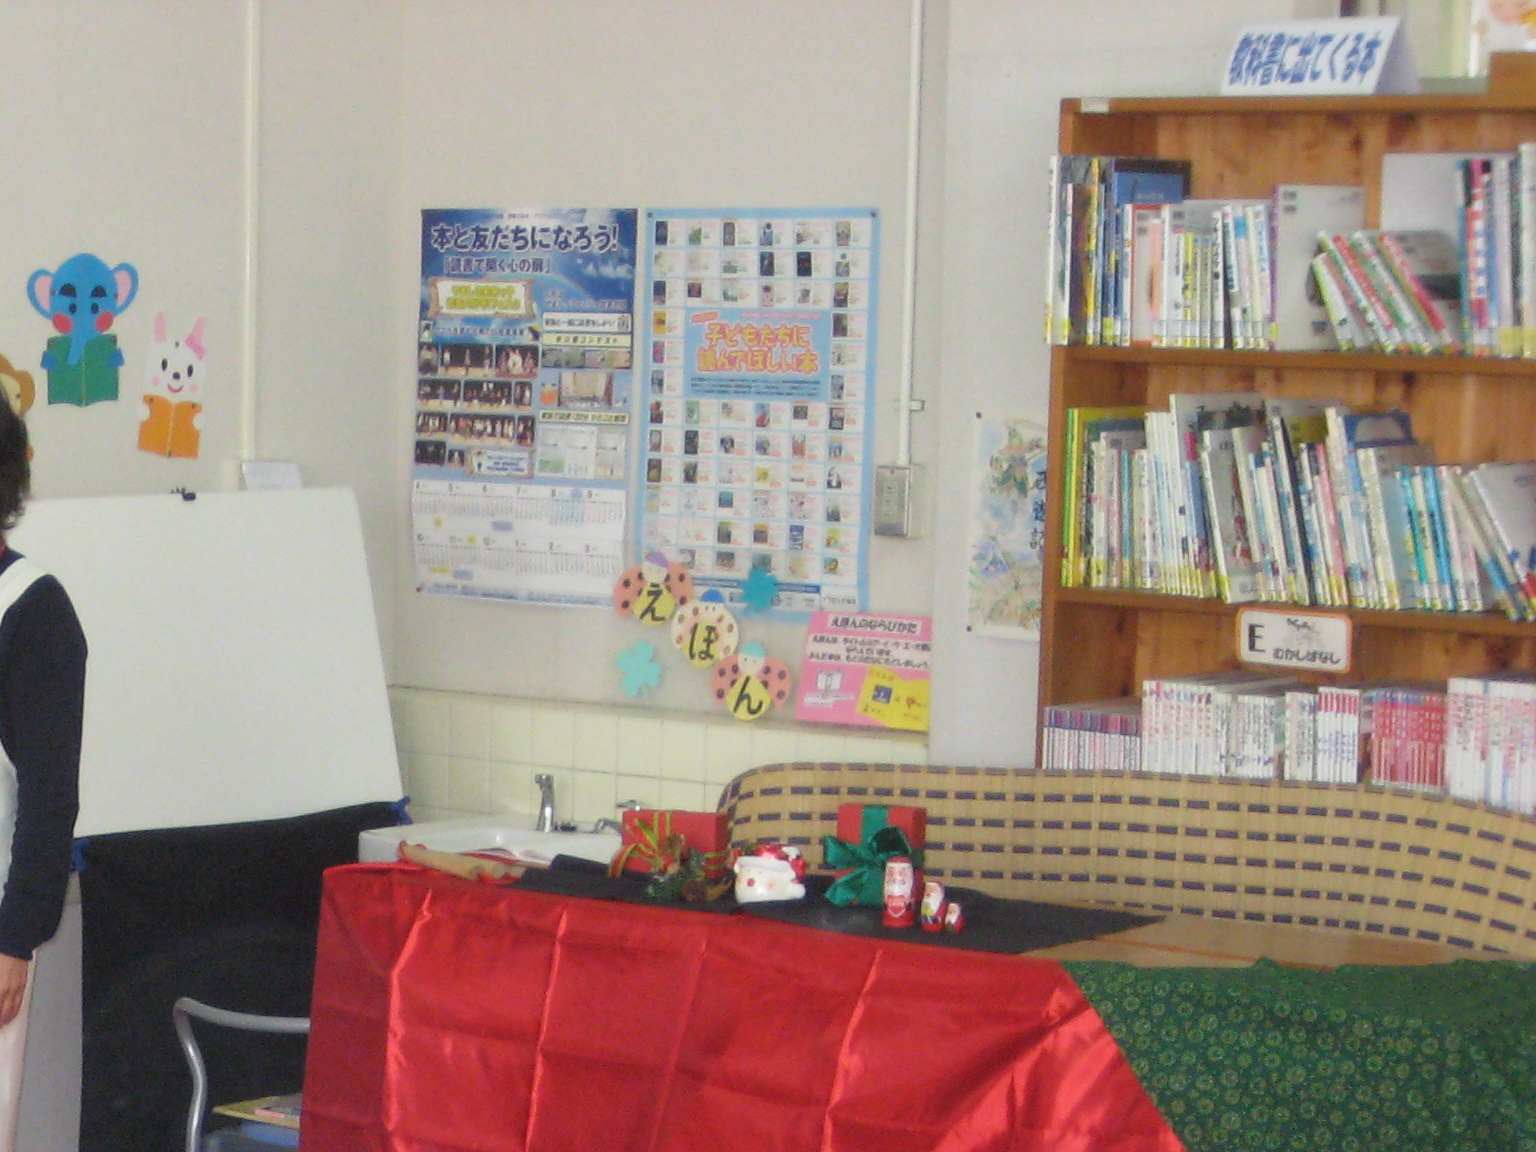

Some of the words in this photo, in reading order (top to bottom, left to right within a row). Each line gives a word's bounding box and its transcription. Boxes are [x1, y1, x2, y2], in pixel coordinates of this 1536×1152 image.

[706, 321, 812, 348] 子どもたちに
[698, 346, 820, 374] 読んでほしい本
[1248, 623, 1266, 652] E
[1272, 647, 1342, 664] むかしばなし
